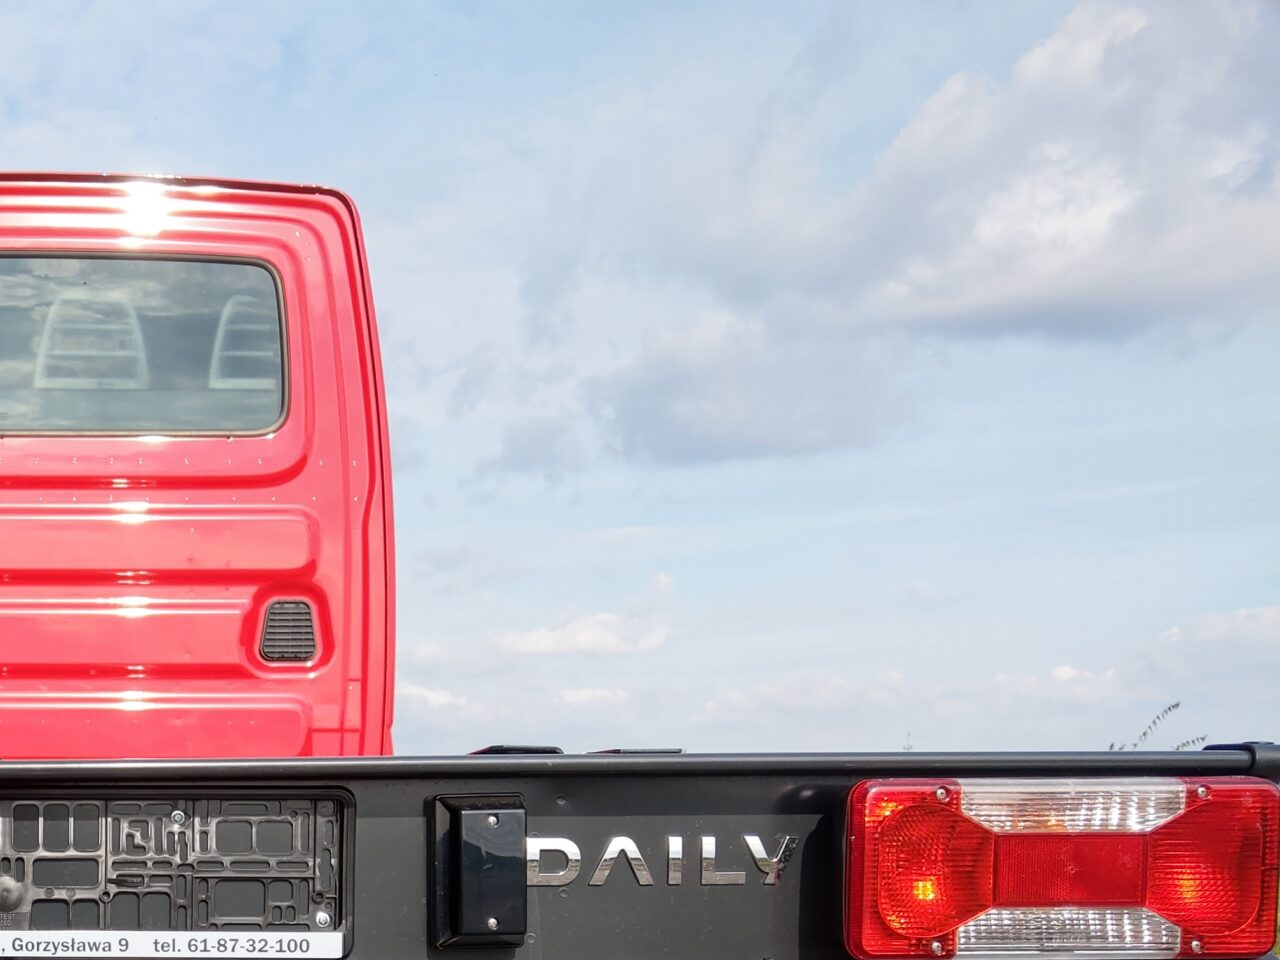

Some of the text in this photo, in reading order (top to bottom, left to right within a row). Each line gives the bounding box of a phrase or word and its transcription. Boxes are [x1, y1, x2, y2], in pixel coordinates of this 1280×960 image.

[525, 835, 801, 887] DAILY
[11, 937, 112, 954] Gorzysława
[118, 938, 130, 952] 9
[153, 938, 182, 953] tel.
[187, 938, 311, 953] 61-87-32-100
